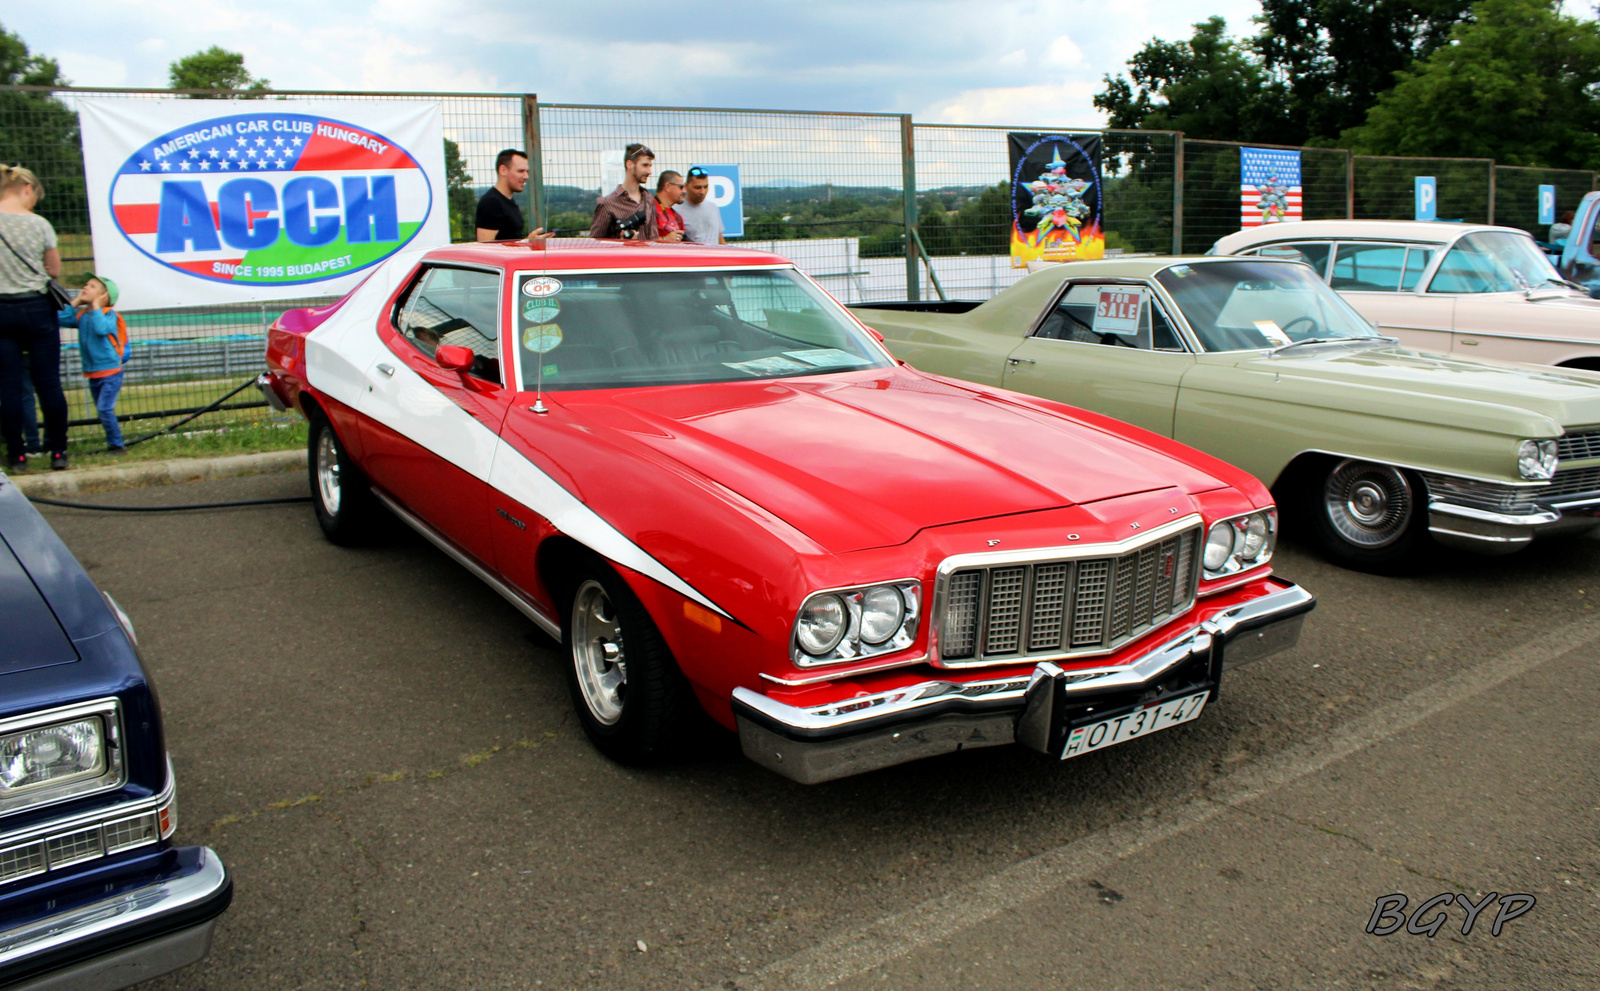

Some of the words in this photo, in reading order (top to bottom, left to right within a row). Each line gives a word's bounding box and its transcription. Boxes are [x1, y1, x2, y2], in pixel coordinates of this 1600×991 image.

[153, 123, 233, 160] AMERICAN
[235, 120, 269, 134] CAR
[272, 119, 314, 134] CLUB
[316, 123, 389, 155] HUNGARY
[1420, 183, 1434, 212] P
[1542, 191, 1553, 216] P
[155, 174, 400, 254] ACCH
[212, 261, 252, 277] SINCE
[255, 265, 284, 278] 1995
[286, 254, 352, 277] BUDAPEST
[526, 298, 547, 309] CLUB
[1098, 301, 1137, 319] SALE
[1110, 293, 1129, 303] FOR
[1066, 742, 1080, 755] H
